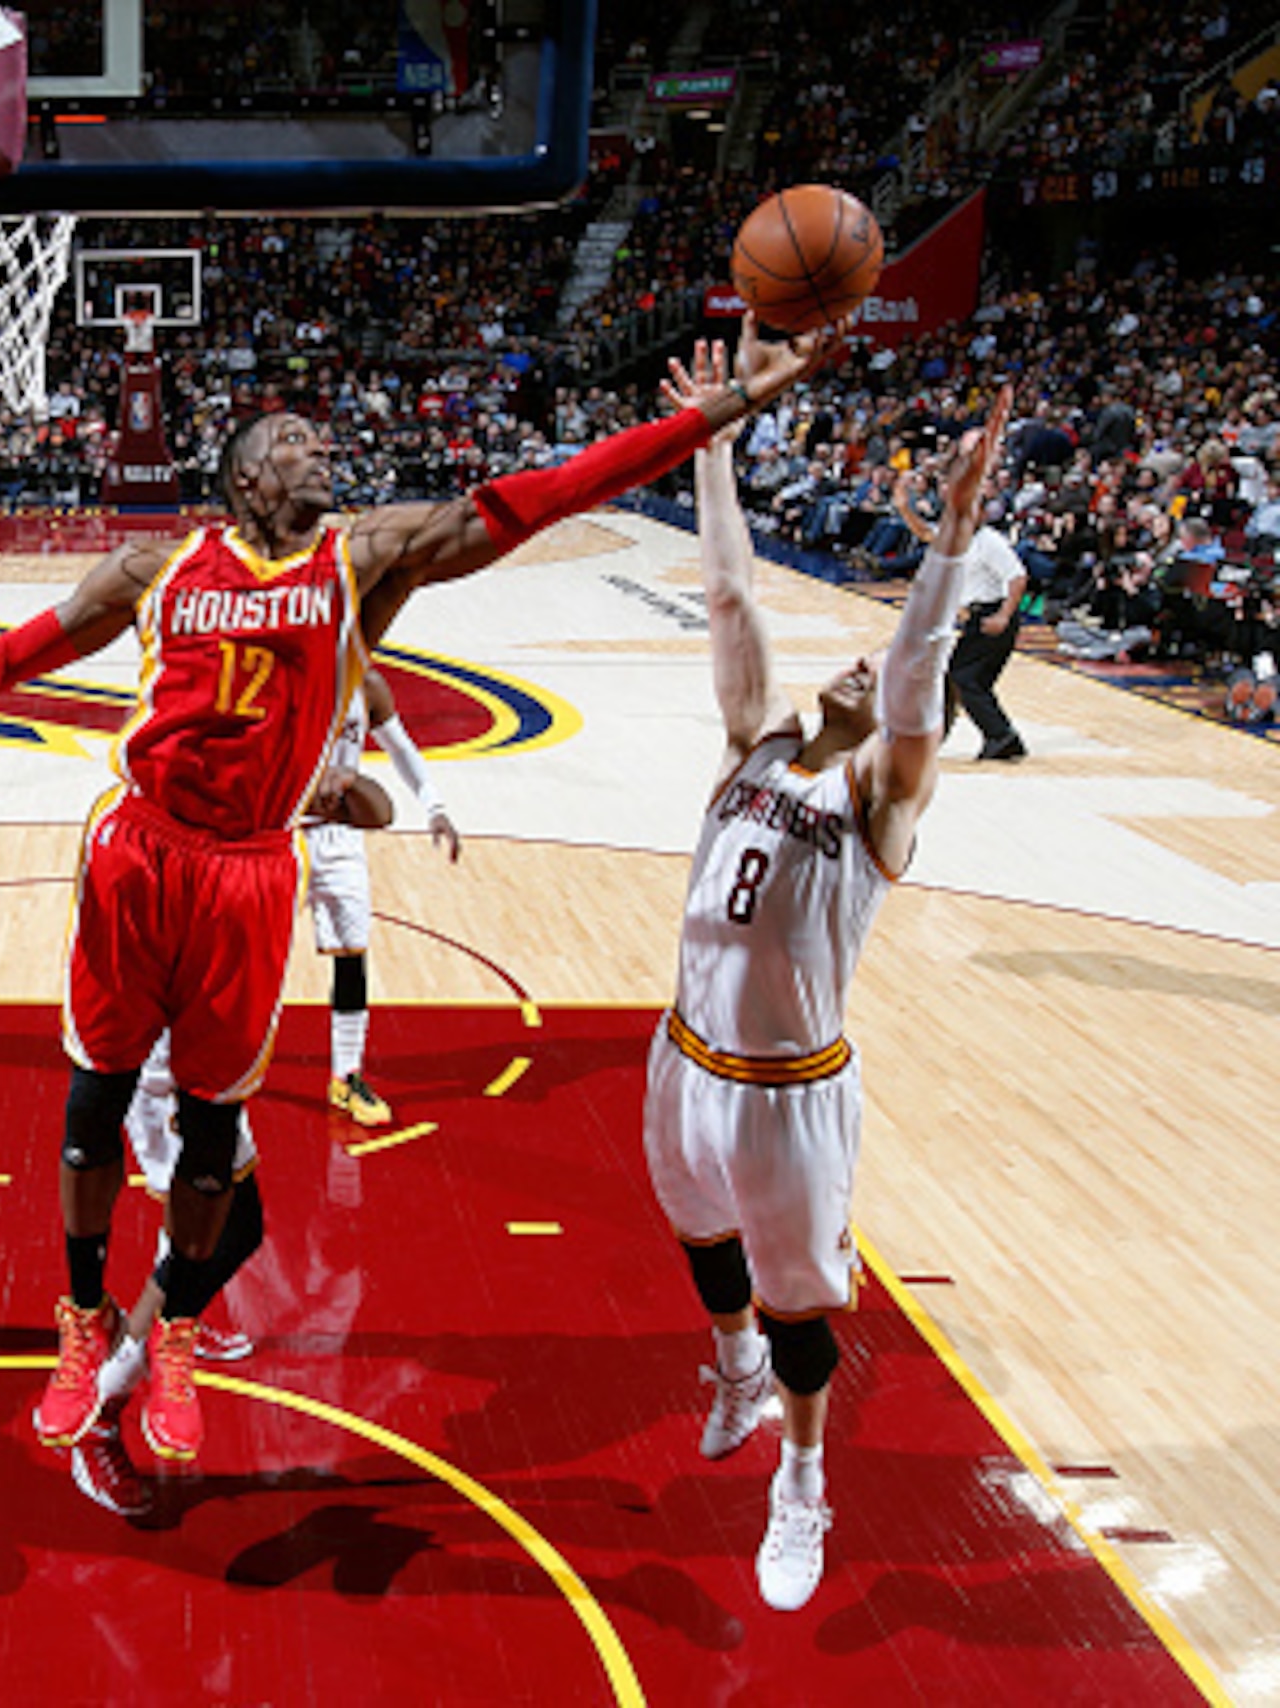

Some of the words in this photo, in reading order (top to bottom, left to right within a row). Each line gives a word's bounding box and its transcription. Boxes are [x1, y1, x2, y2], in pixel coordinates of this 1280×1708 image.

[171, 582, 332, 634] HOUSTON
[215, 641, 274, 718] 12
[727, 849, 766, 923] 8
